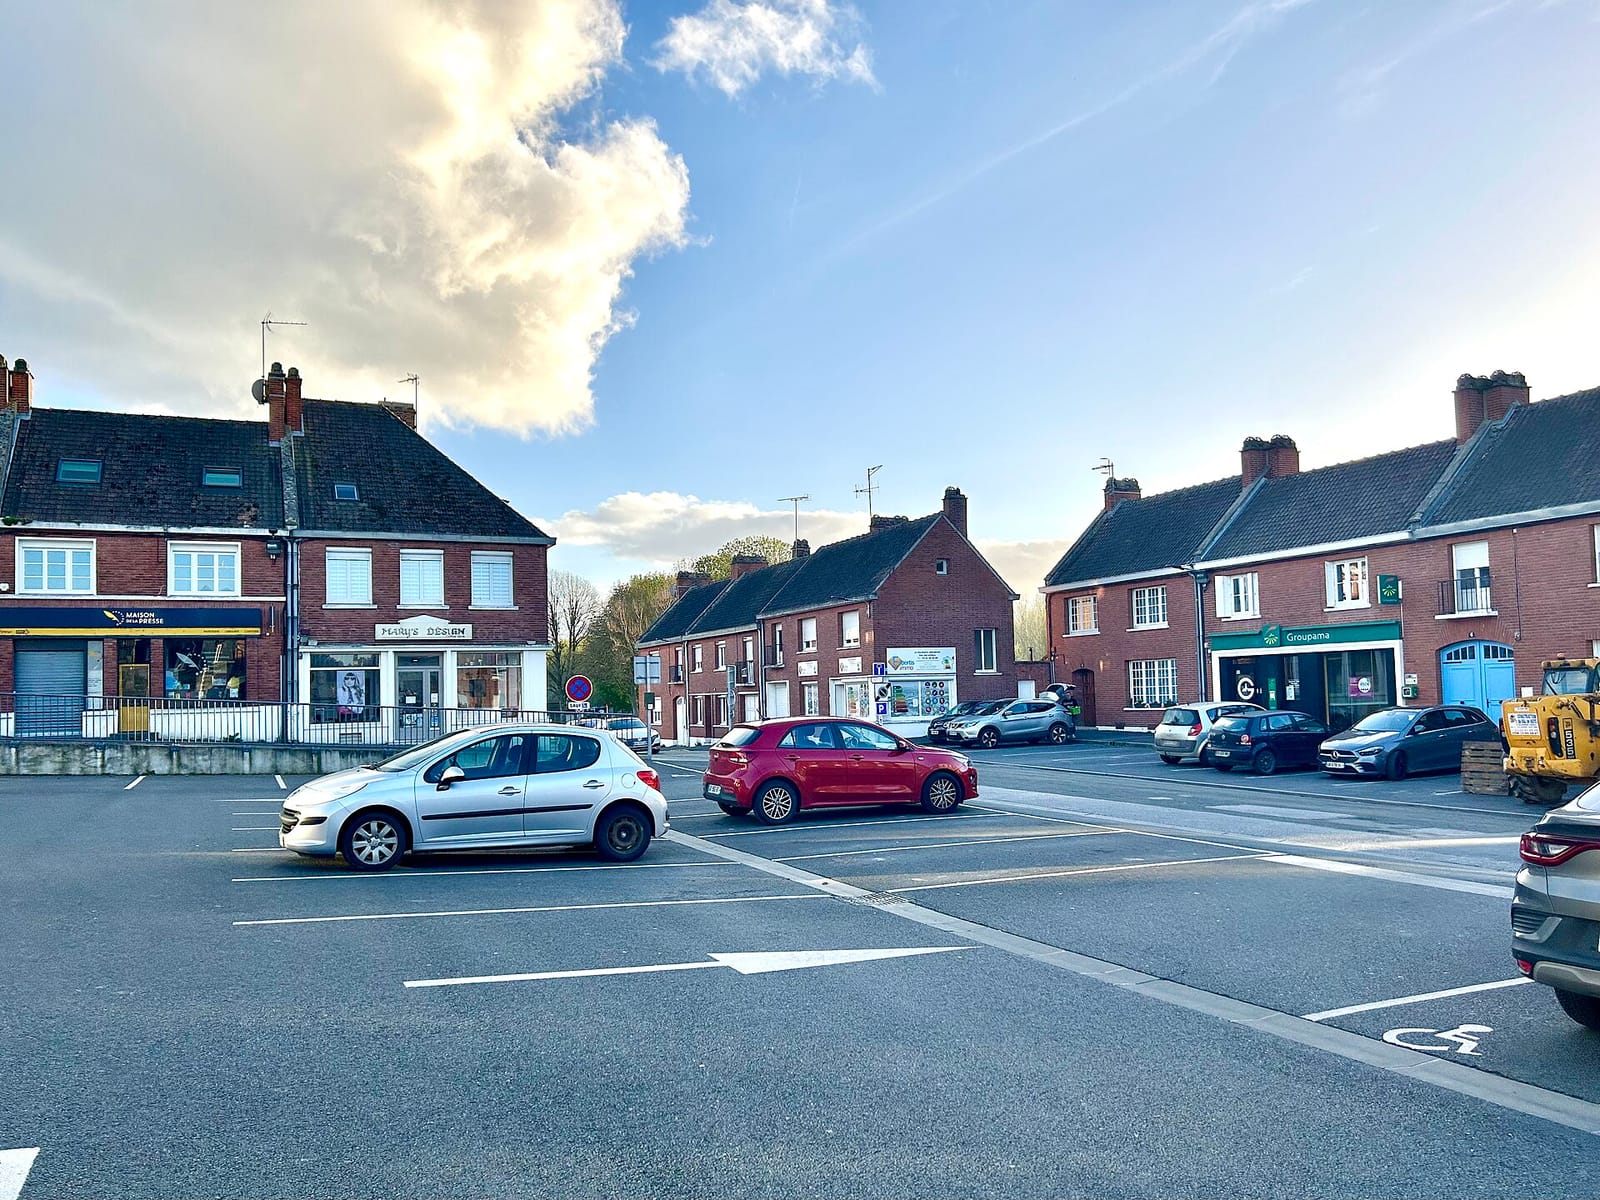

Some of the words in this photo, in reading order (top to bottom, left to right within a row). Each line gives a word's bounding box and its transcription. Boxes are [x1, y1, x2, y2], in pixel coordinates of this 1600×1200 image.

[426, 626, 466, 636] DESIGN
[1286, 632, 1330, 642] Groupama
[1565, 731, 1575, 755] 535
